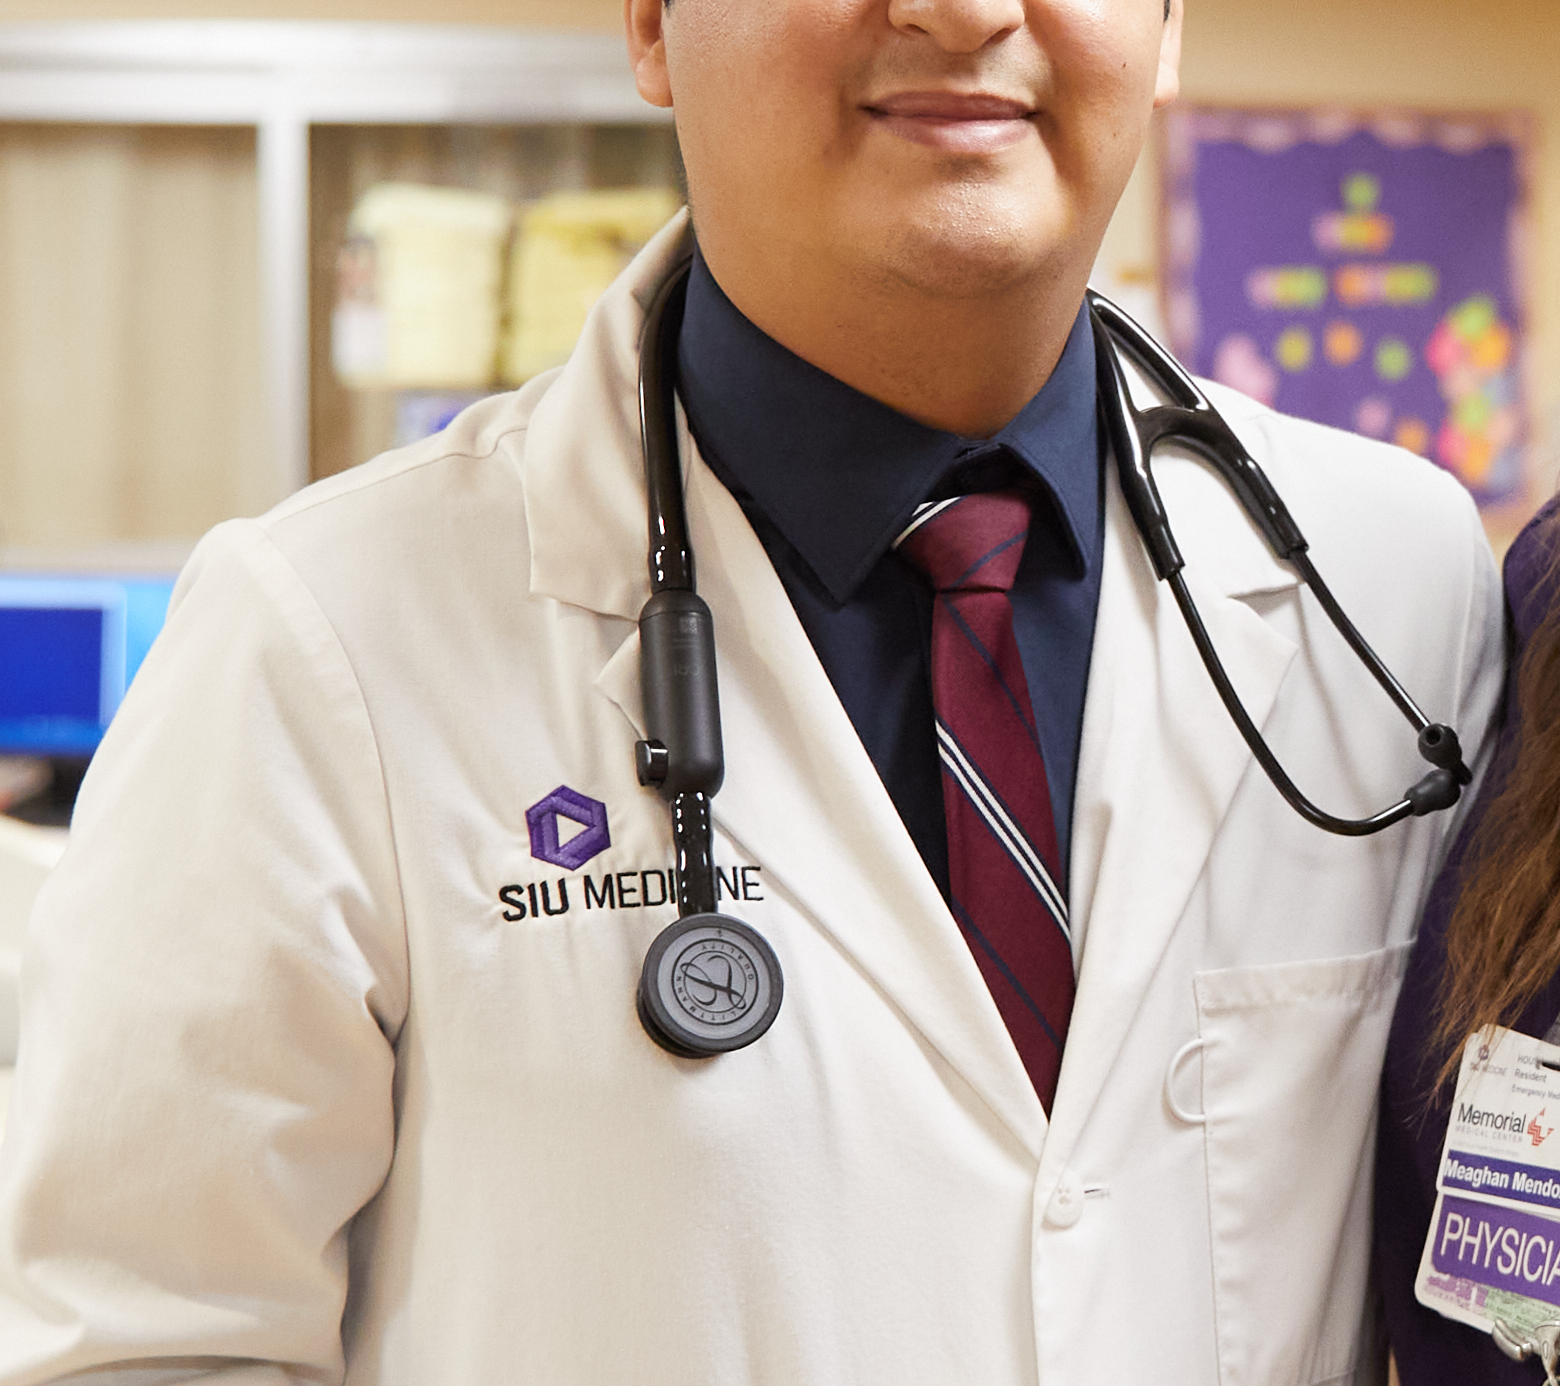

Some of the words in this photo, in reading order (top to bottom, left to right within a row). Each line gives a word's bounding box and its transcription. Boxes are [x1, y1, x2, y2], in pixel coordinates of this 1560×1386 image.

[498, 878, 570, 922] SIU
[583, 866, 765, 910] MEDINE
[1514, 1068, 1547, 1082] Resident
[1457, 1102, 1527, 1134] Memorial
[1443, 1159, 1510, 1187] Meaghan
